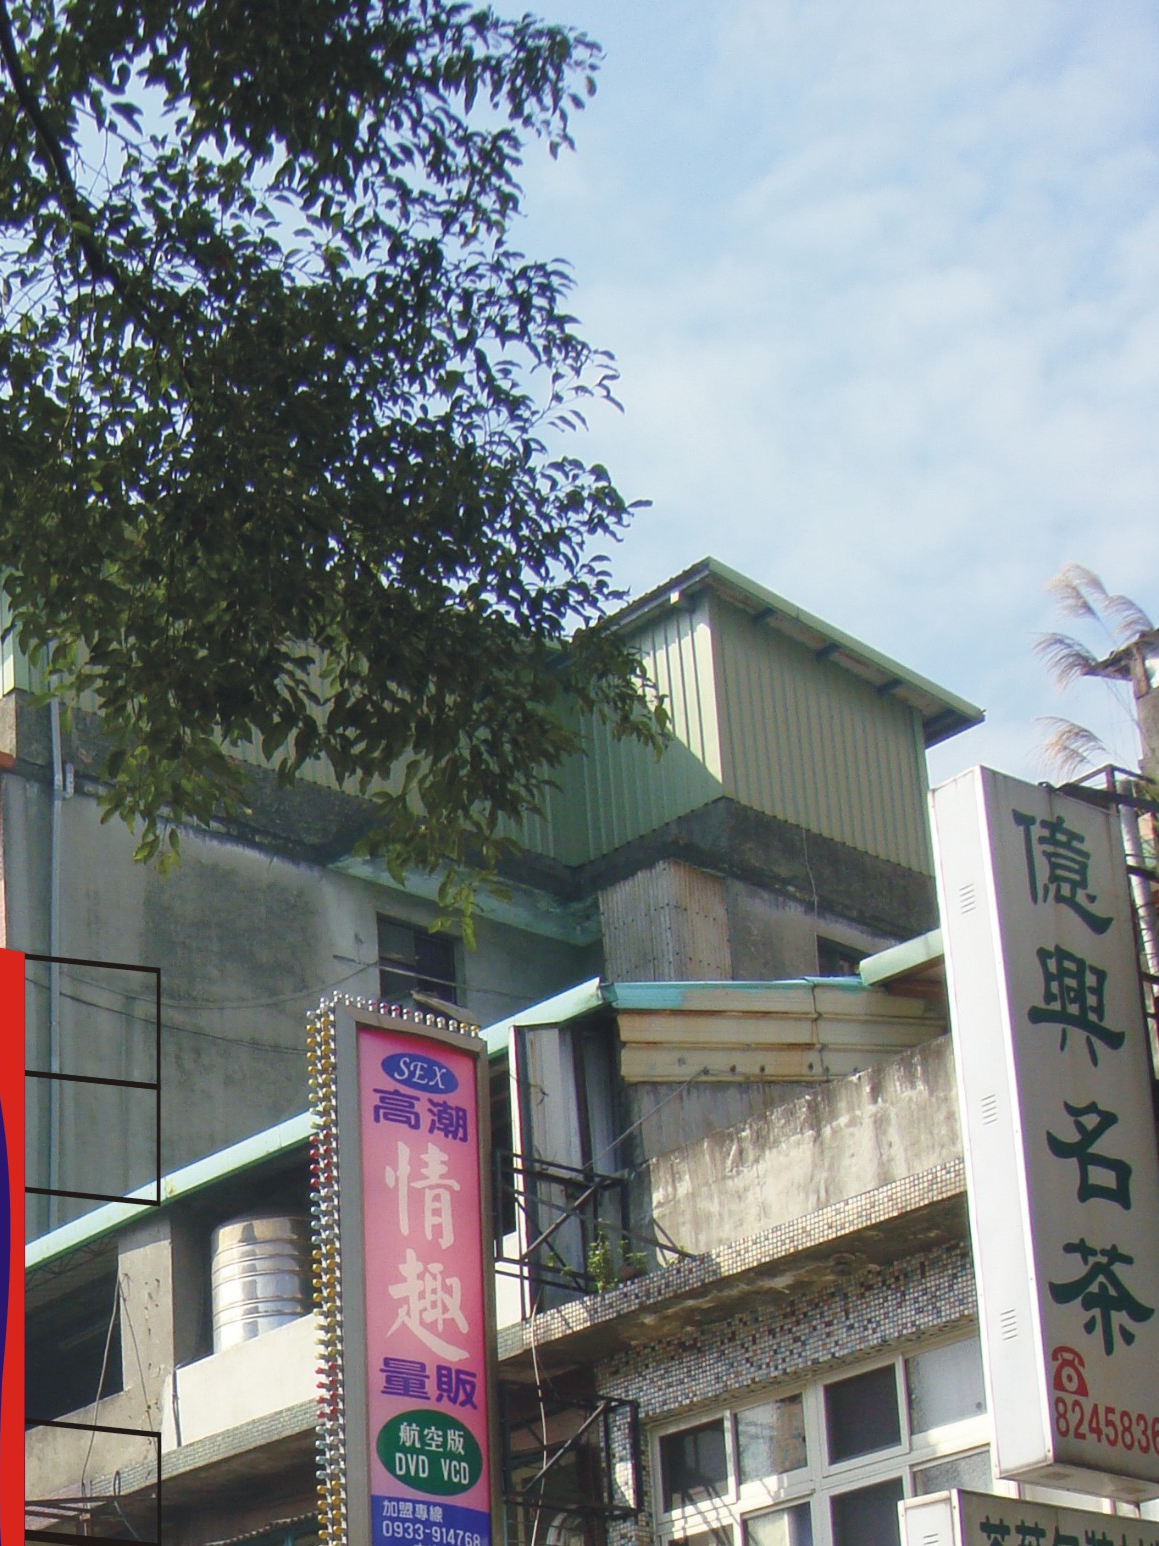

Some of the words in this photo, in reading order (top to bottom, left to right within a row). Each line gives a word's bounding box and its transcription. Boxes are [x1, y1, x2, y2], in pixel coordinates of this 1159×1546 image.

[394, 1057, 447, 1089] SEX
[1011, 807, 1155, 1356] 億興名茶
[372, 1088, 469, 1143] 高潮
[385, 1141, 470, 1362] 情趣
[379, 1357, 478, 1410] 量販
[399, 1421, 466, 1456] 航空版
[1054, 1396, 1159, 1456] 8245836
[395, 1453, 429, 1479] DVD
[441, 1458, 470, 1485] VCD
[382, 1500, 444, 1524] 加盟專線
